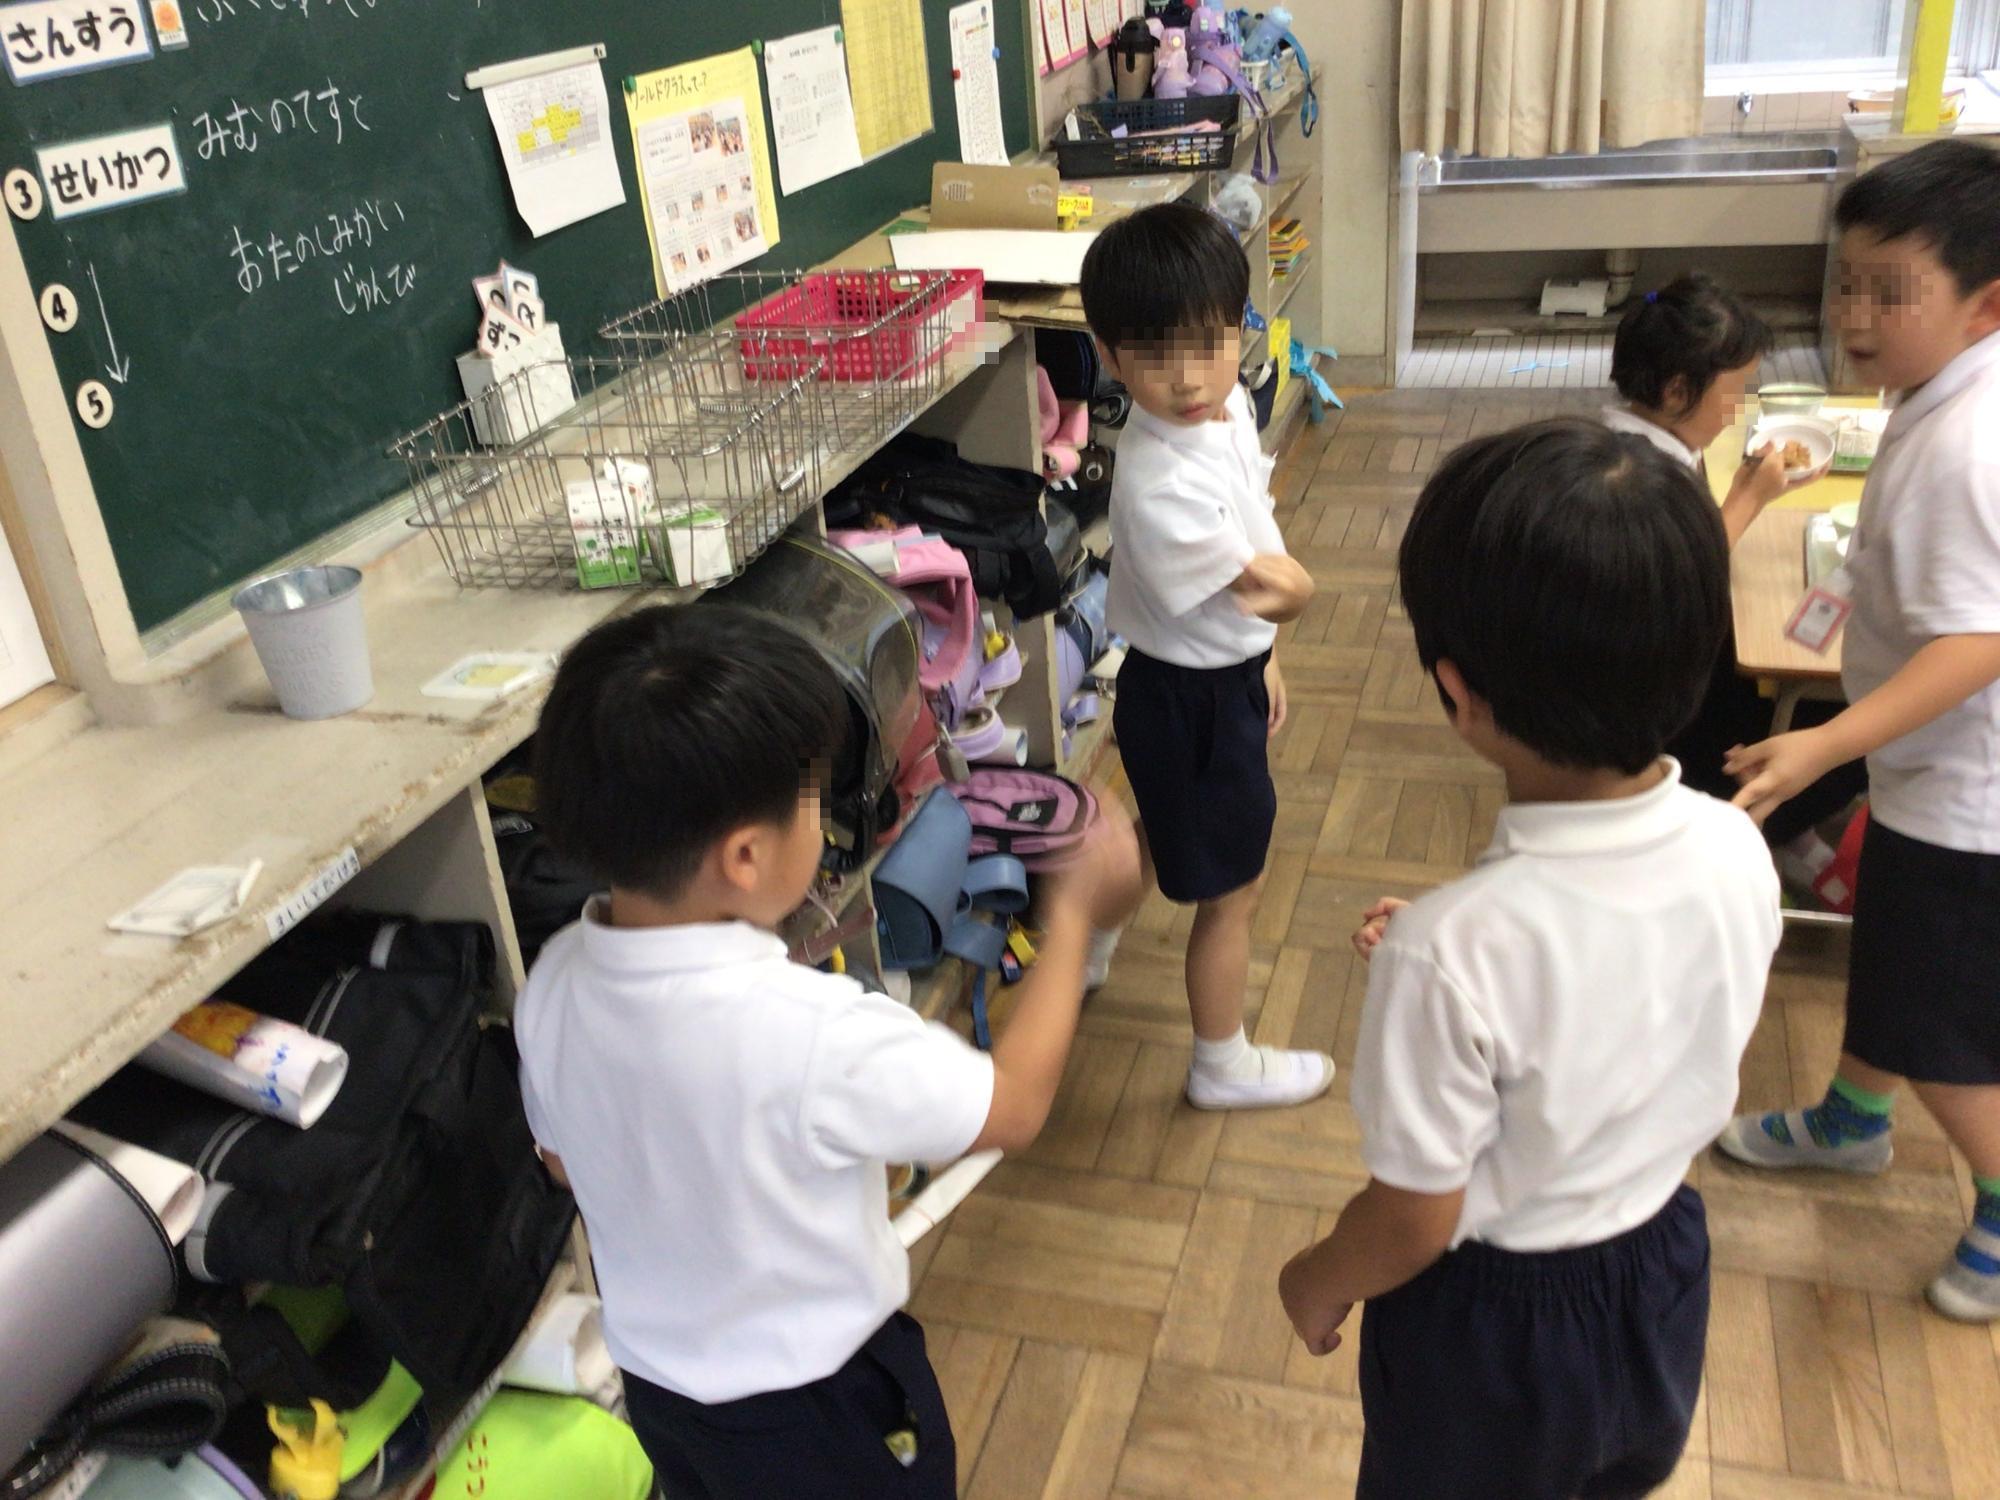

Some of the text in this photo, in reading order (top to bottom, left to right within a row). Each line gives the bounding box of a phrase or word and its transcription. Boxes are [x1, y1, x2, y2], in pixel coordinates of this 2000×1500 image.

[8, 7, 136, 64] さんすう
[51, 146, 171, 205] せいかつ
